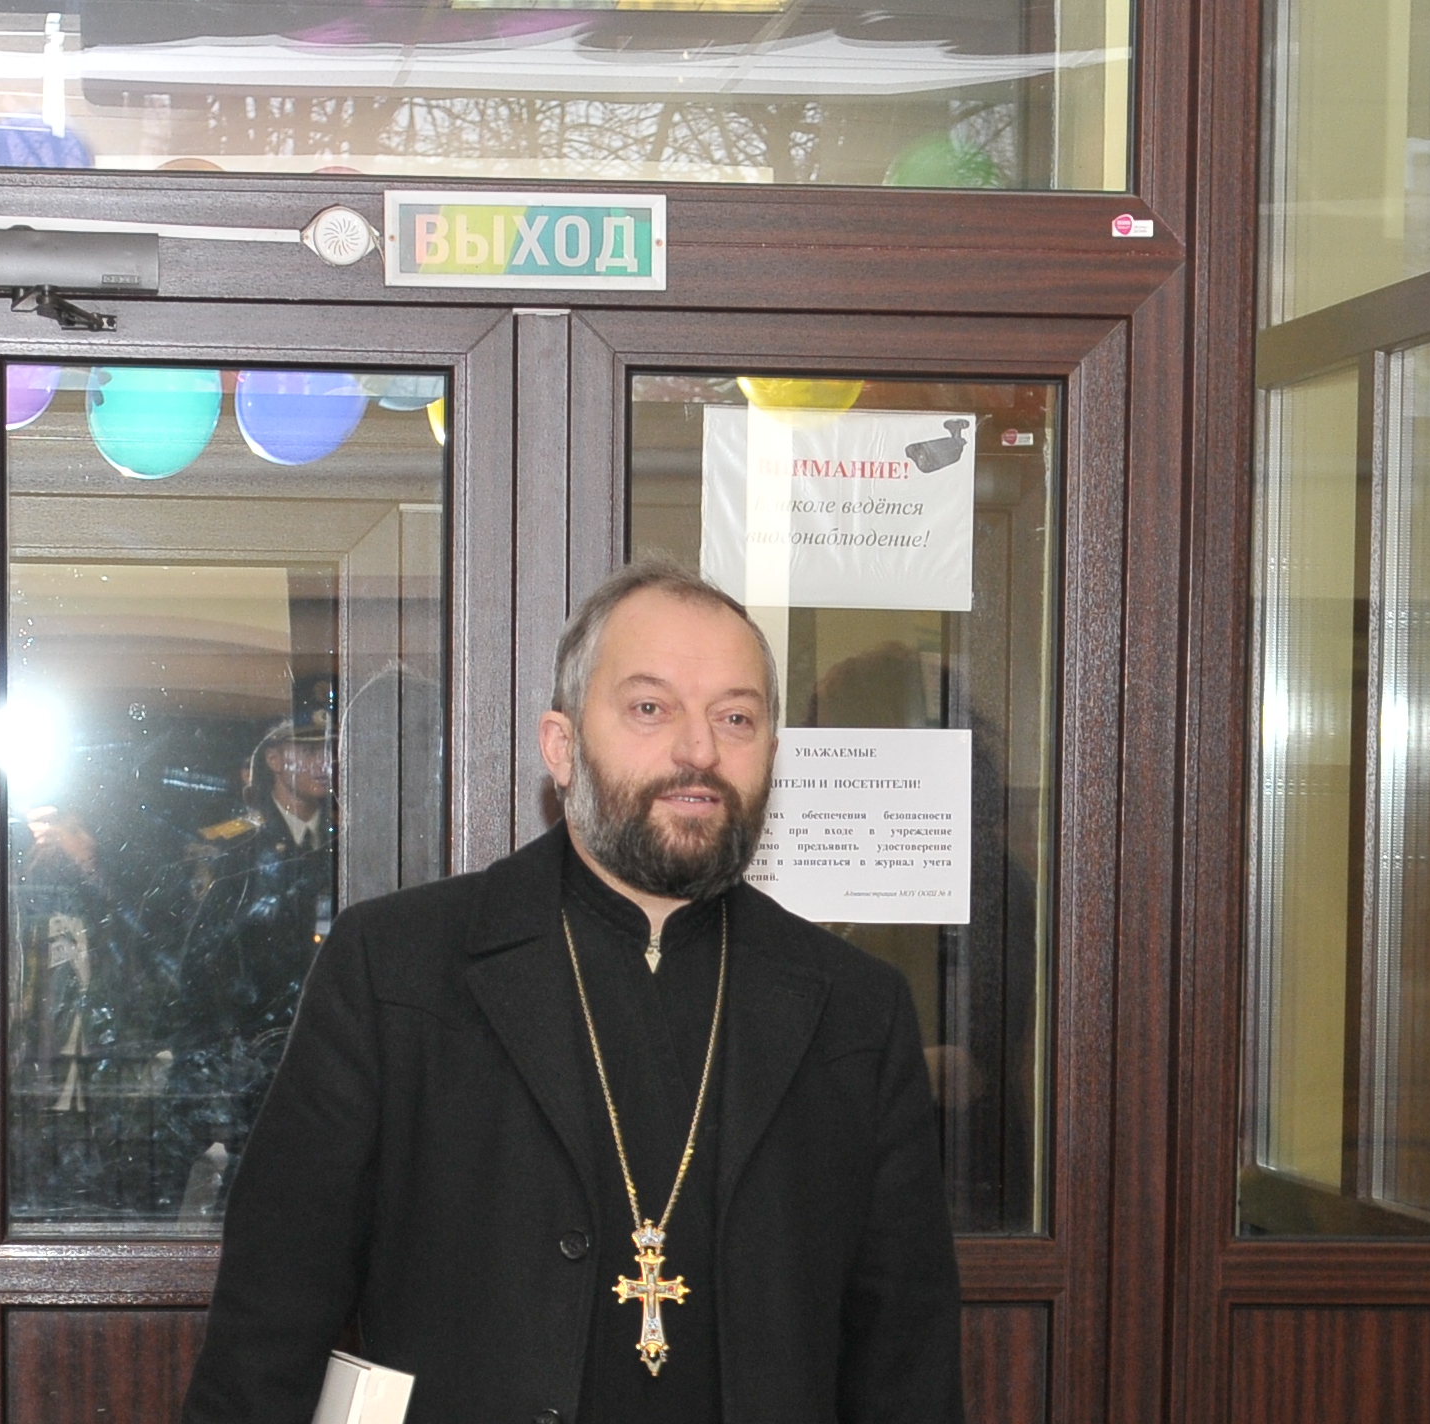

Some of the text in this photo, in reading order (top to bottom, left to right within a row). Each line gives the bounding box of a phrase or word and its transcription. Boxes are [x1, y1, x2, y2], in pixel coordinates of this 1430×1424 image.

[414, 213, 639, 273] ВЫХОД
[841, 496, 924, 516] ведётся
[794, 747, 878, 758] УВАЖАЕМЫЕ
[819, 778, 828, 789] И
[833, 778, 921, 790] ПОСЕТИТЕЛИ!
[801, 810, 867, 821] обеспечения
[883, 810, 952, 821] безопасности
[788, 827, 809, 837] при
[824, 827, 854, 836] входе
[890, 827, 952, 838] учреждение
[797, 843, 952, 852] предъявить удостоверение
[792, 858, 851, 867] записаться
[874, 858, 914, 868] журнал
[922, 858, 952, 868] учета
